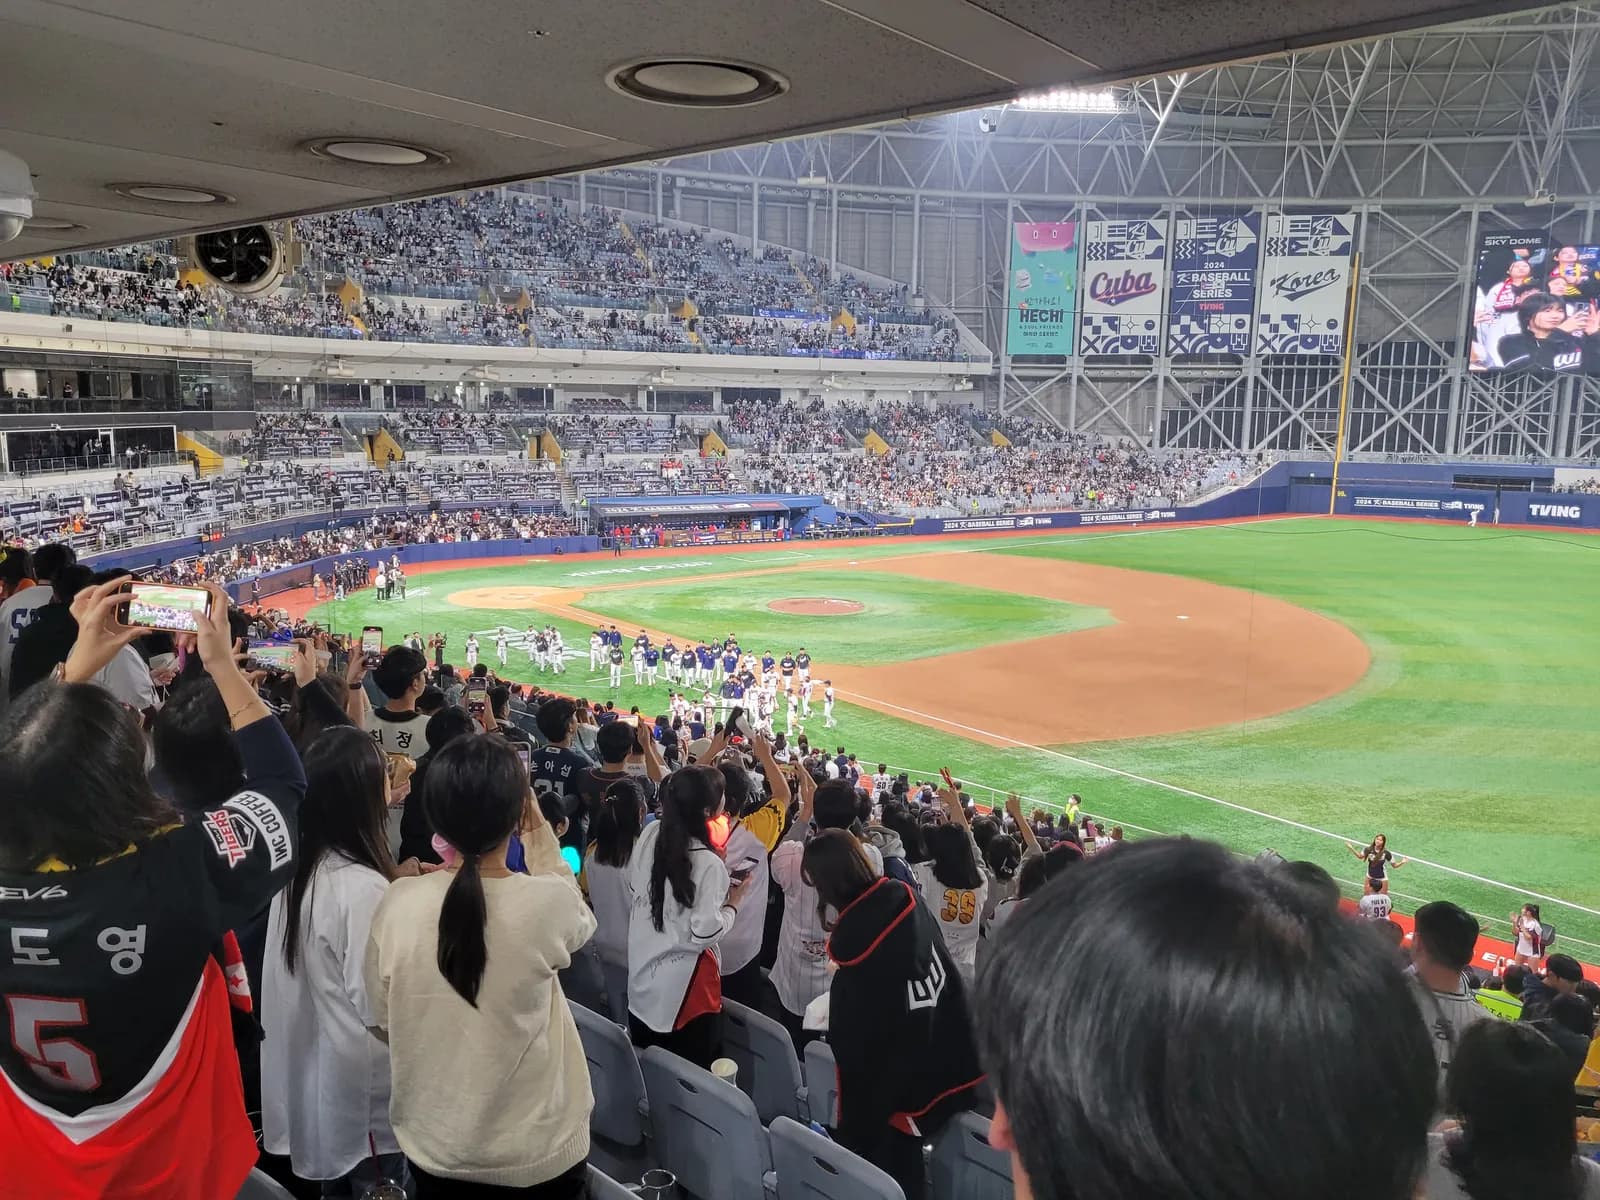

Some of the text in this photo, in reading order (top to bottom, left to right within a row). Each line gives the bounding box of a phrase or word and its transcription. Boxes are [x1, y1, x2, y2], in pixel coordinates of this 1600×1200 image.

[1509, 237, 1543, 245] DOME
[1203, 261, 1225, 269] 2024
[1089, 268, 1157, 306] Cuba
[1269, 268, 1340, 301] Korea
[1192, 288, 1233, 299] SERIES
[1199, 303, 1225, 311] TVING
[1019, 308, 1064, 323] HECHI
[1463, 503, 1485, 511] TVING
[1529, 504, 1581, 518] TVING
[943, 521, 959, 529] 2024
[232, 793, 281, 834] COFFEE
[211, 810, 244, 864] TIGERS
[0, 884, 68, 900] EV6
[940, 887, 977, 925] 39
[1373, 905, 1387, 918] 93
[5, 993, 101, 1093] 5
